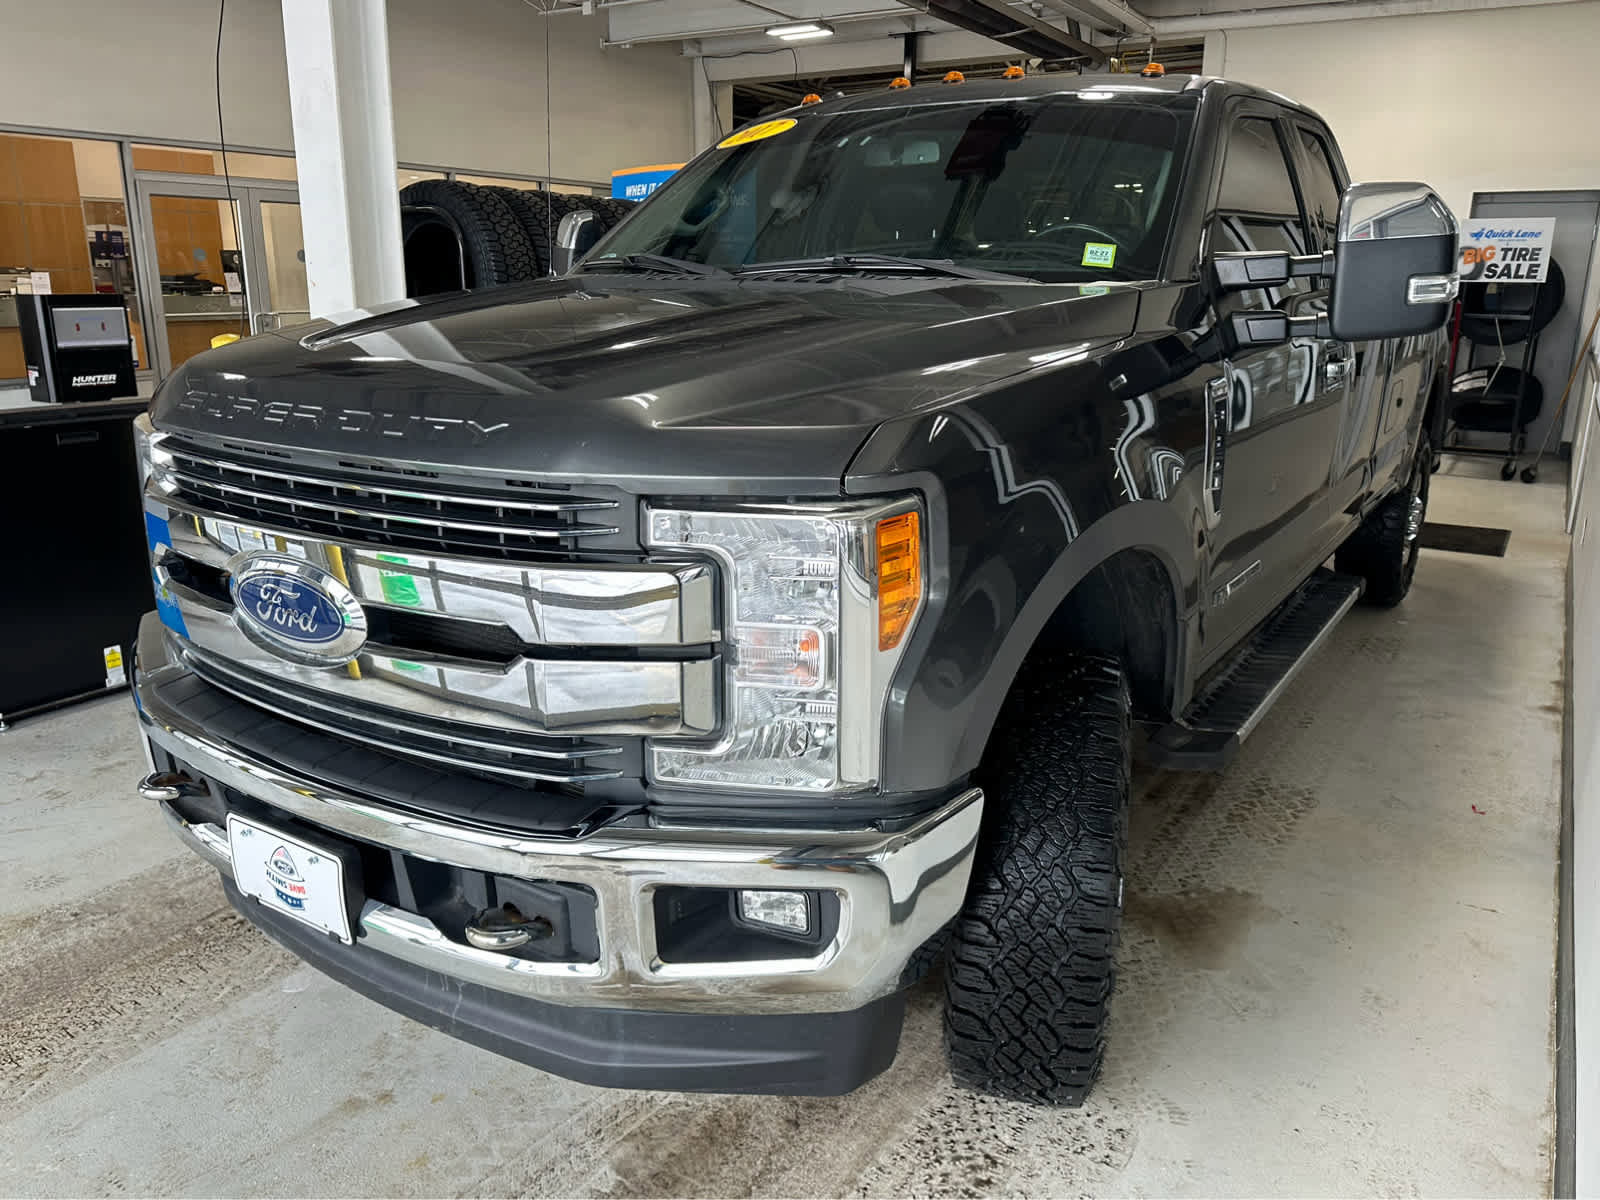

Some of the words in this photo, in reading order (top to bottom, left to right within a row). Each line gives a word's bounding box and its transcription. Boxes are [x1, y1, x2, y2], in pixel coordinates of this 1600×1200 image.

[626, 183, 648, 197] WHEN
[1485, 228, 1514, 239] Quick
[1514, 228, 1542, 239] Lane
[1463, 245, 1496, 264] BIG
[1500, 247, 1543, 262] TIRE
[1484, 263, 1541, 280] SALE
[72, 373, 117, 384] HUNTER
[256, 583, 318, 633] Ford
[266, 869, 288, 889] SMITH
